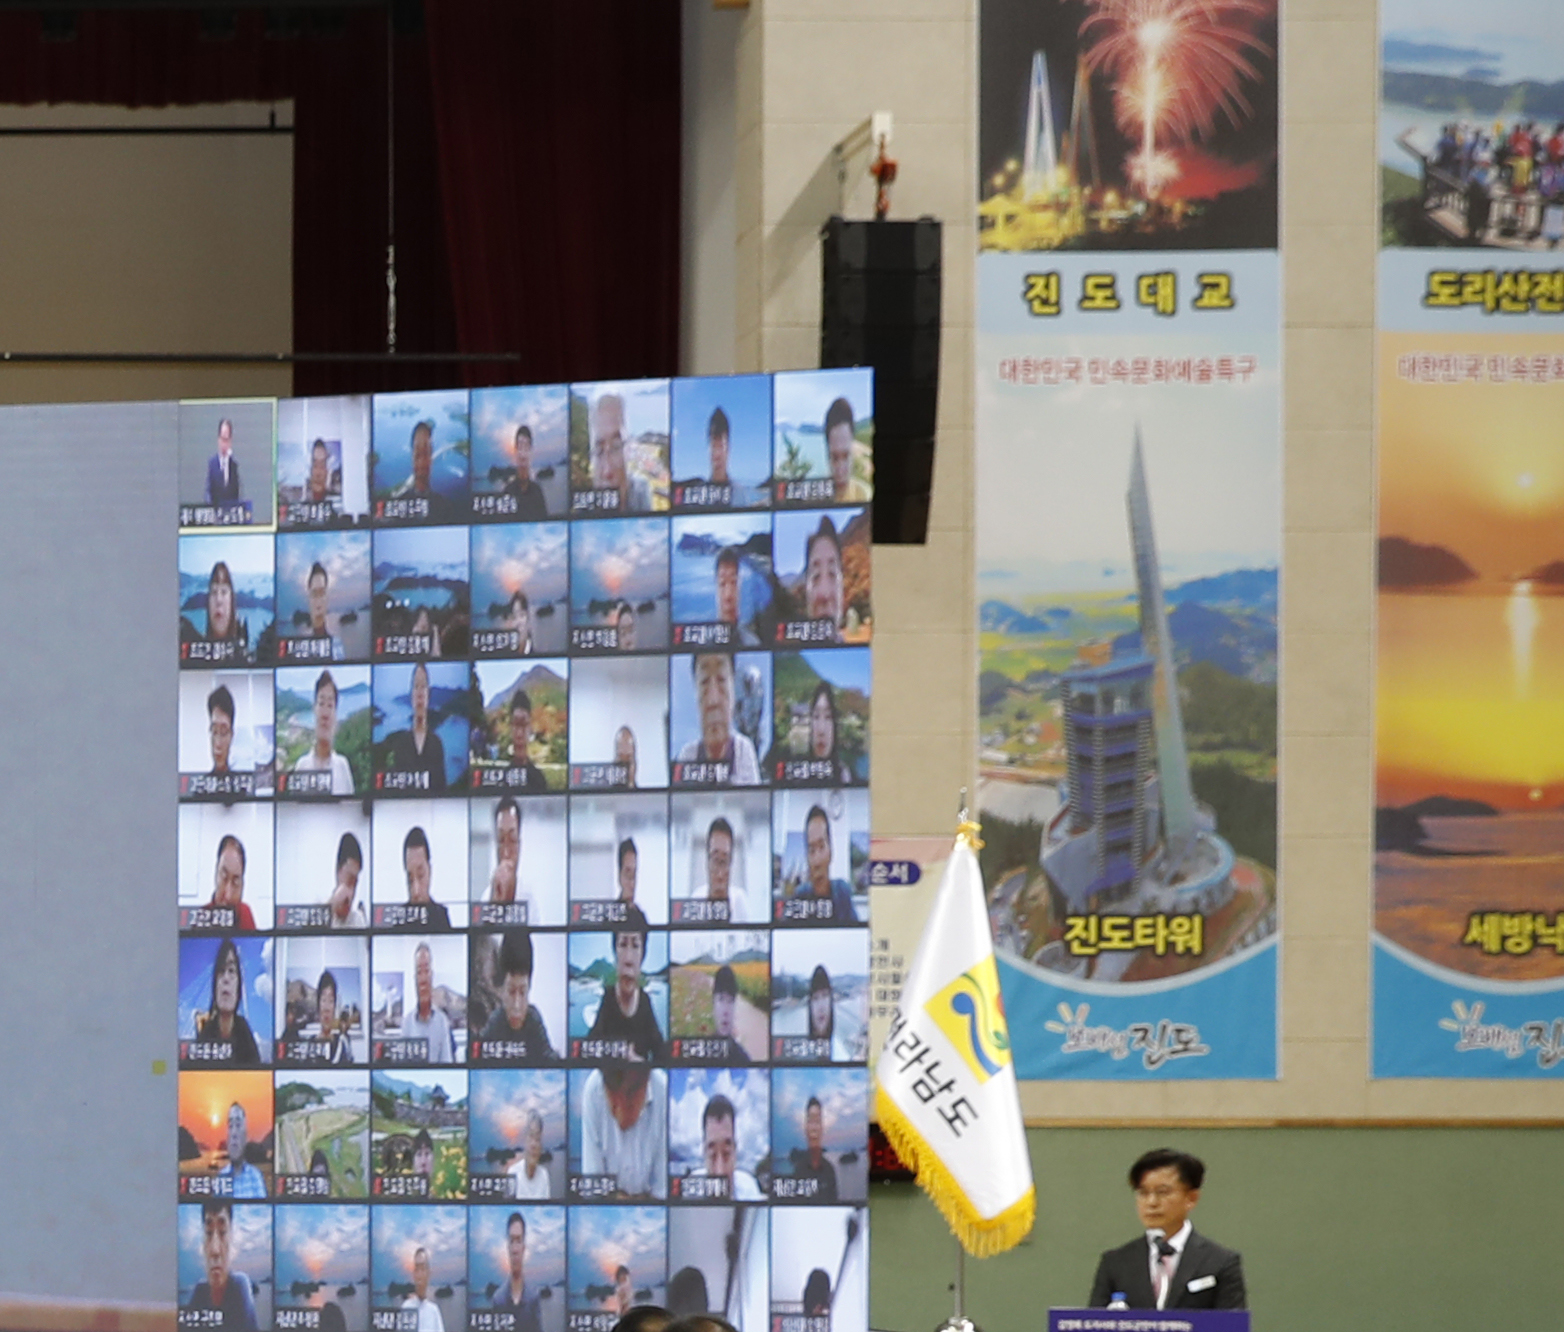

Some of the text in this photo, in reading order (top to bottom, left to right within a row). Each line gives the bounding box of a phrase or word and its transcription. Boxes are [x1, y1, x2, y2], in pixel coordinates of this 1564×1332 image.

[998, 356, 1083, 386] 대한민국
[1397, 354, 1484, 384] 대한민국
[1063, 913, 1205, 956] 진도타워
[1130, 1019, 1211, 1070] 진도
